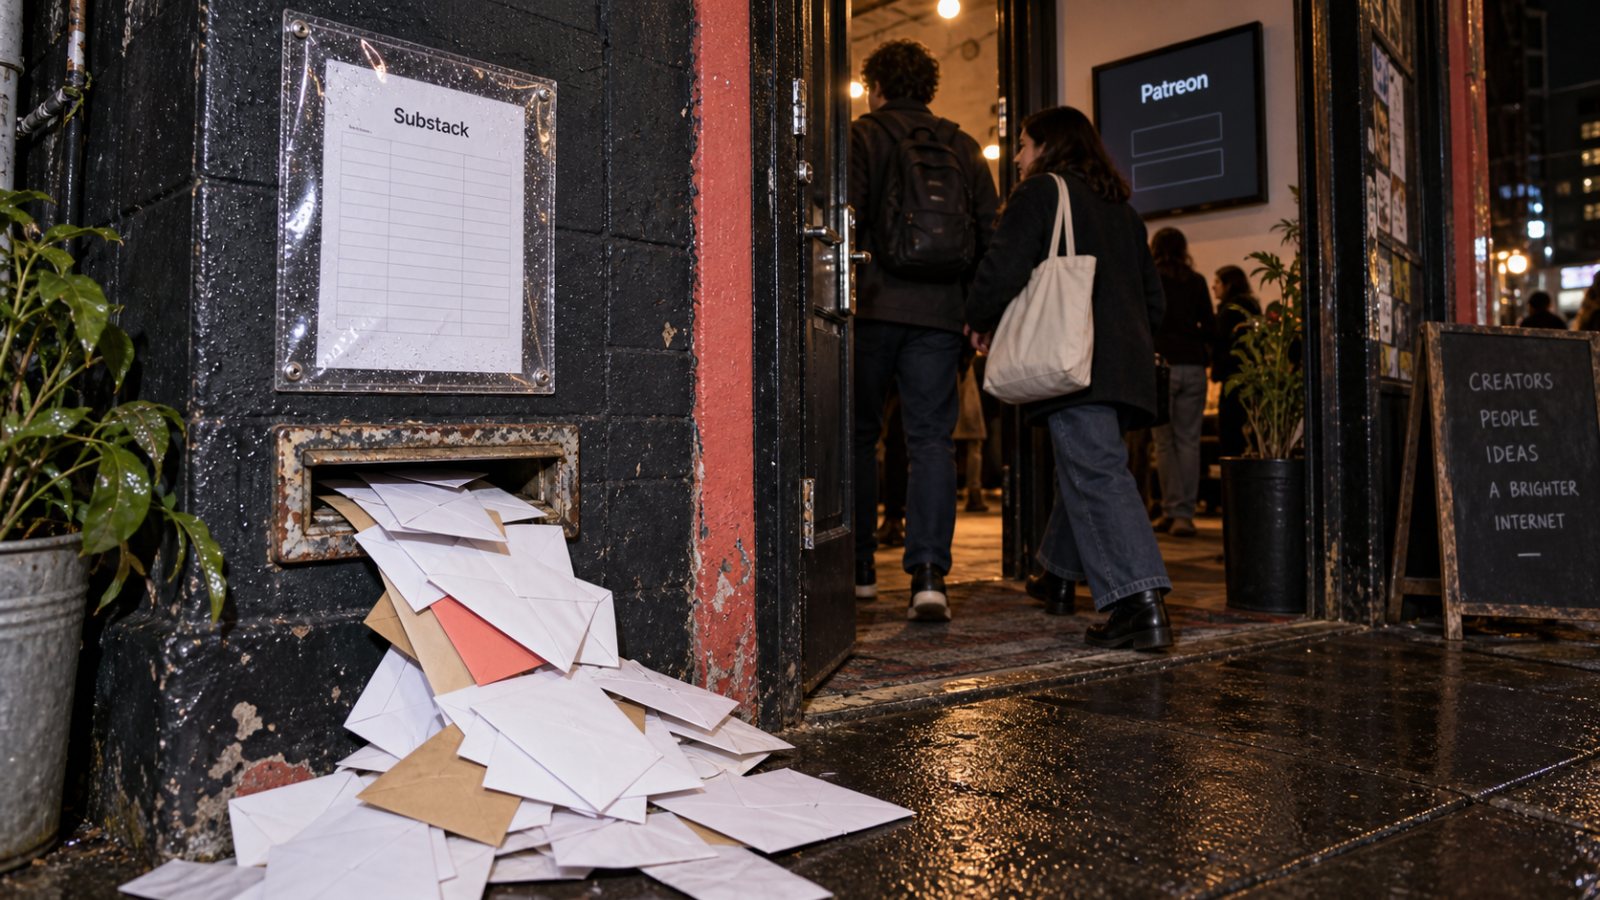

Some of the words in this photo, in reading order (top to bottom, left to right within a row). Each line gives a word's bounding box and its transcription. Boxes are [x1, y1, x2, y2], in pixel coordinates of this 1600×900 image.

[1141, 73, 1208, 104] Patreon
[394, 107, 469, 138] Substack
[1469, 372, 1553, 391] CREATORS
[1480, 409, 1540, 429] PEOPLE
[1486, 444, 1539, 463] IDEAS
[1489, 481, 1500, 498] A
[1510, 480, 1579, 498] BRIGHTER
[1495, 513, 1565, 531] INTERNET
